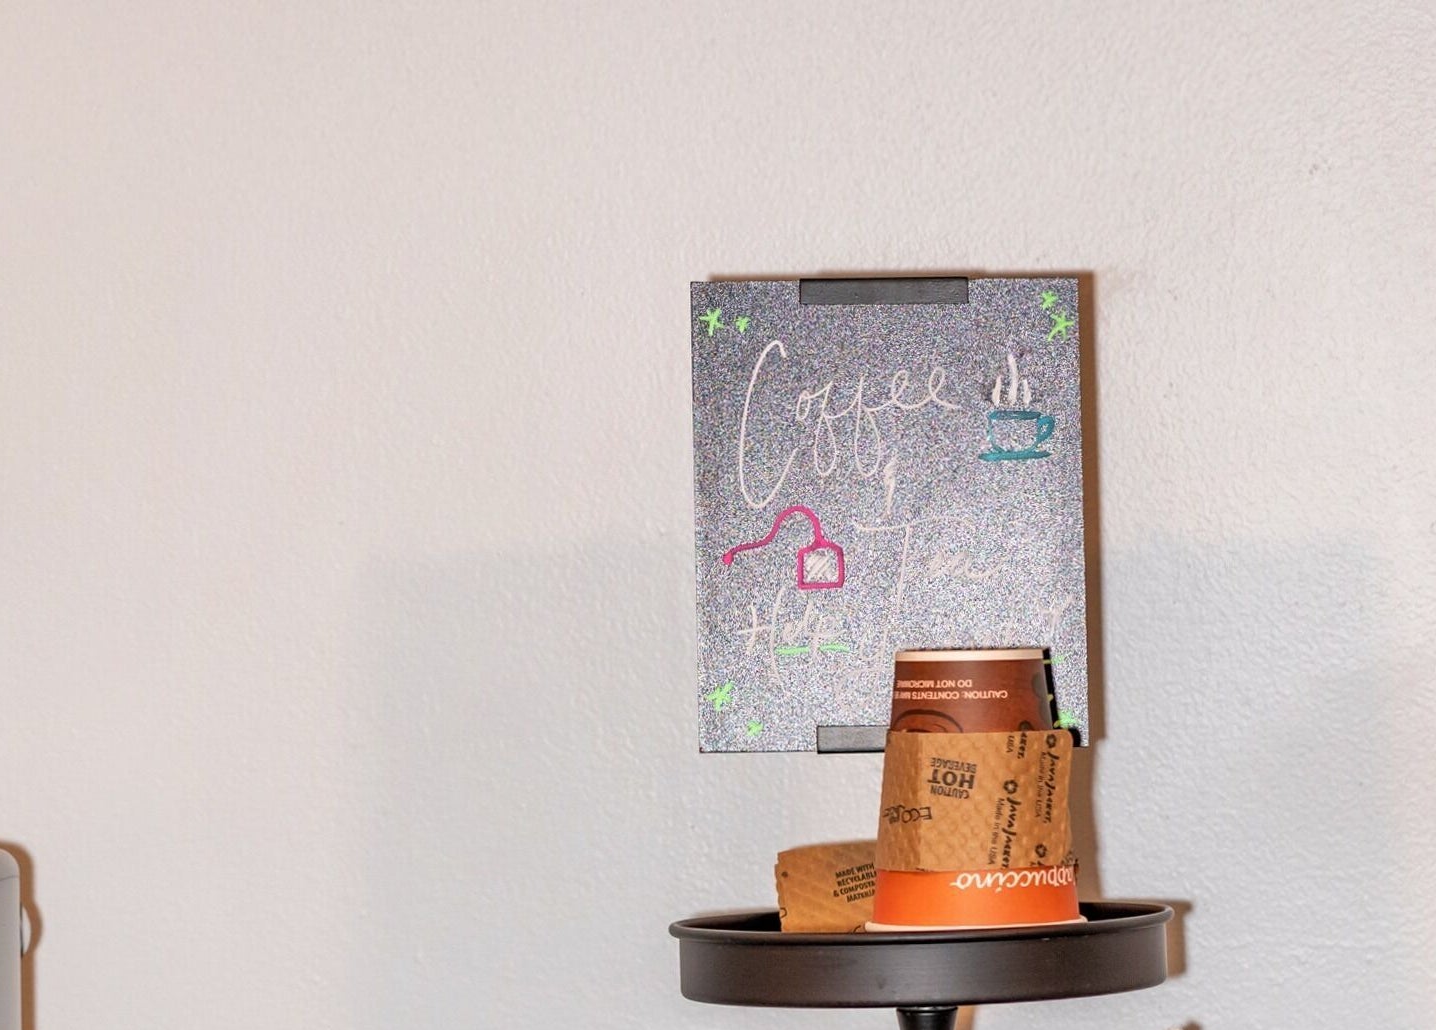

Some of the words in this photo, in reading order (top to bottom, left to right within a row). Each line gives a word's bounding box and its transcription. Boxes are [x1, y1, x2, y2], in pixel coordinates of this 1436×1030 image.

[739, 340, 963, 508] Coffee
[935, 679, 955, 688] NOT
[958, 679, 972, 688] DO
[912, 690, 960, 700] CONTENTS
[930, 757, 977, 774] BEVERAGE
[927, 768, 975, 790] HOT
[930, 785, 970, 799] CAUTION
[994, 798, 1005, 821] Made
[988, 846, 998, 866] USA
[835, 867, 855, 879] MADE
